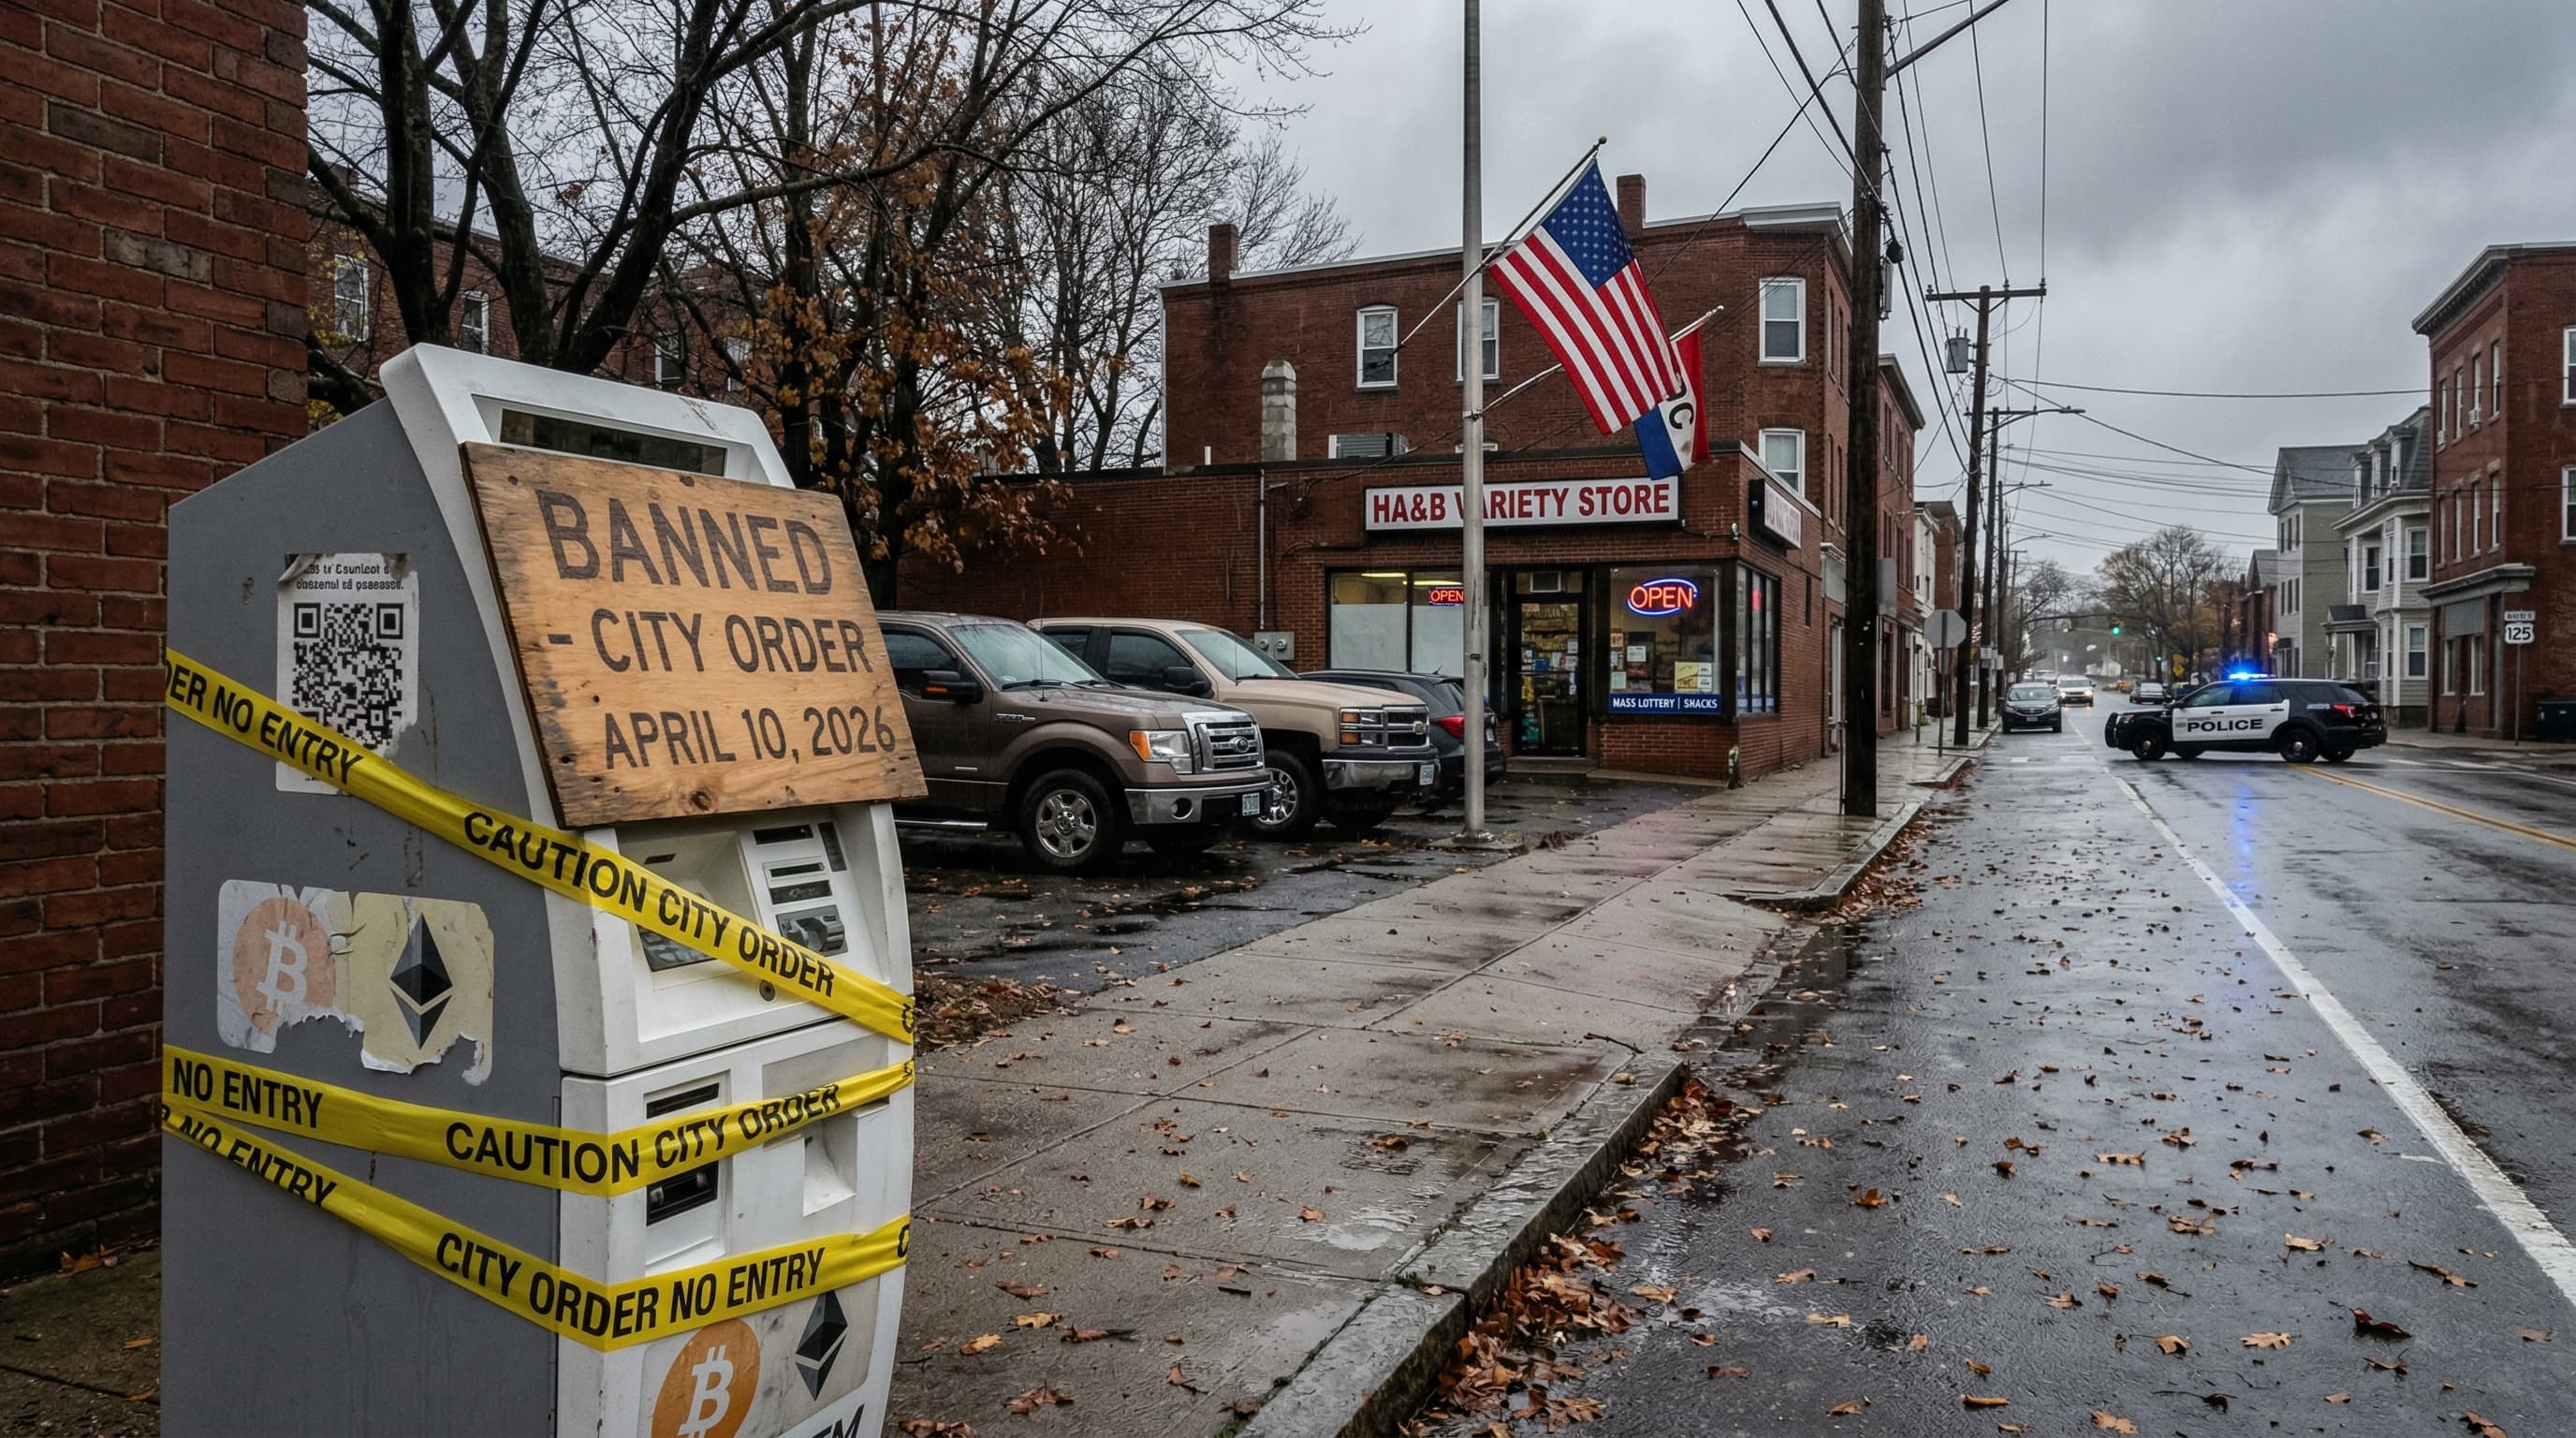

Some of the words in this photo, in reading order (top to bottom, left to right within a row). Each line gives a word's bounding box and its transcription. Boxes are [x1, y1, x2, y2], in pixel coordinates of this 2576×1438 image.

[1373, 492, 1446, 523] HA&B
[1578, 484, 1670, 517] STORE
[535, 489, 832, 595] BANNED
[1430, 590, 1464, 602] OPEN
[1631, 586, 1692, 609] OPEN
[591, 608, 704, 673] CITY
[724, 613, 873, 674] ORDER
[2508, 627, 2531, 640] 125
[212, 685, 254, 733] NO
[260, 711, 364, 785] ENTRY
[1638, 697, 1675, 708] LOTTERY
[2188, 719, 2263, 732] POLICE
[605, 709, 737, 770] APRIL
[741, 707, 799, 765] 10,
[803, 705, 896, 757] 2026
[464, 812, 648, 912] CAUTION
[658, 888, 730, 947] CITY
[739, 926, 834, 997] ORDER
[173, 1058, 213, 1102] NO
[224, 1071, 323, 1128] ENTRY
[446, 1122, 639, 1184] CAUTION
[655, 1114, 729, 1168] CITY
[739, 1083, 841, 1139] ORDER
[227, 1138, 337, 1207] ENTRY
[436, 1232, 521, 1298] CITY
[529, 1271, 660, 1339] ORDER
[669, 1272, 716, 1324] NO
[726, 1247, 826, 1308] ENTRY
